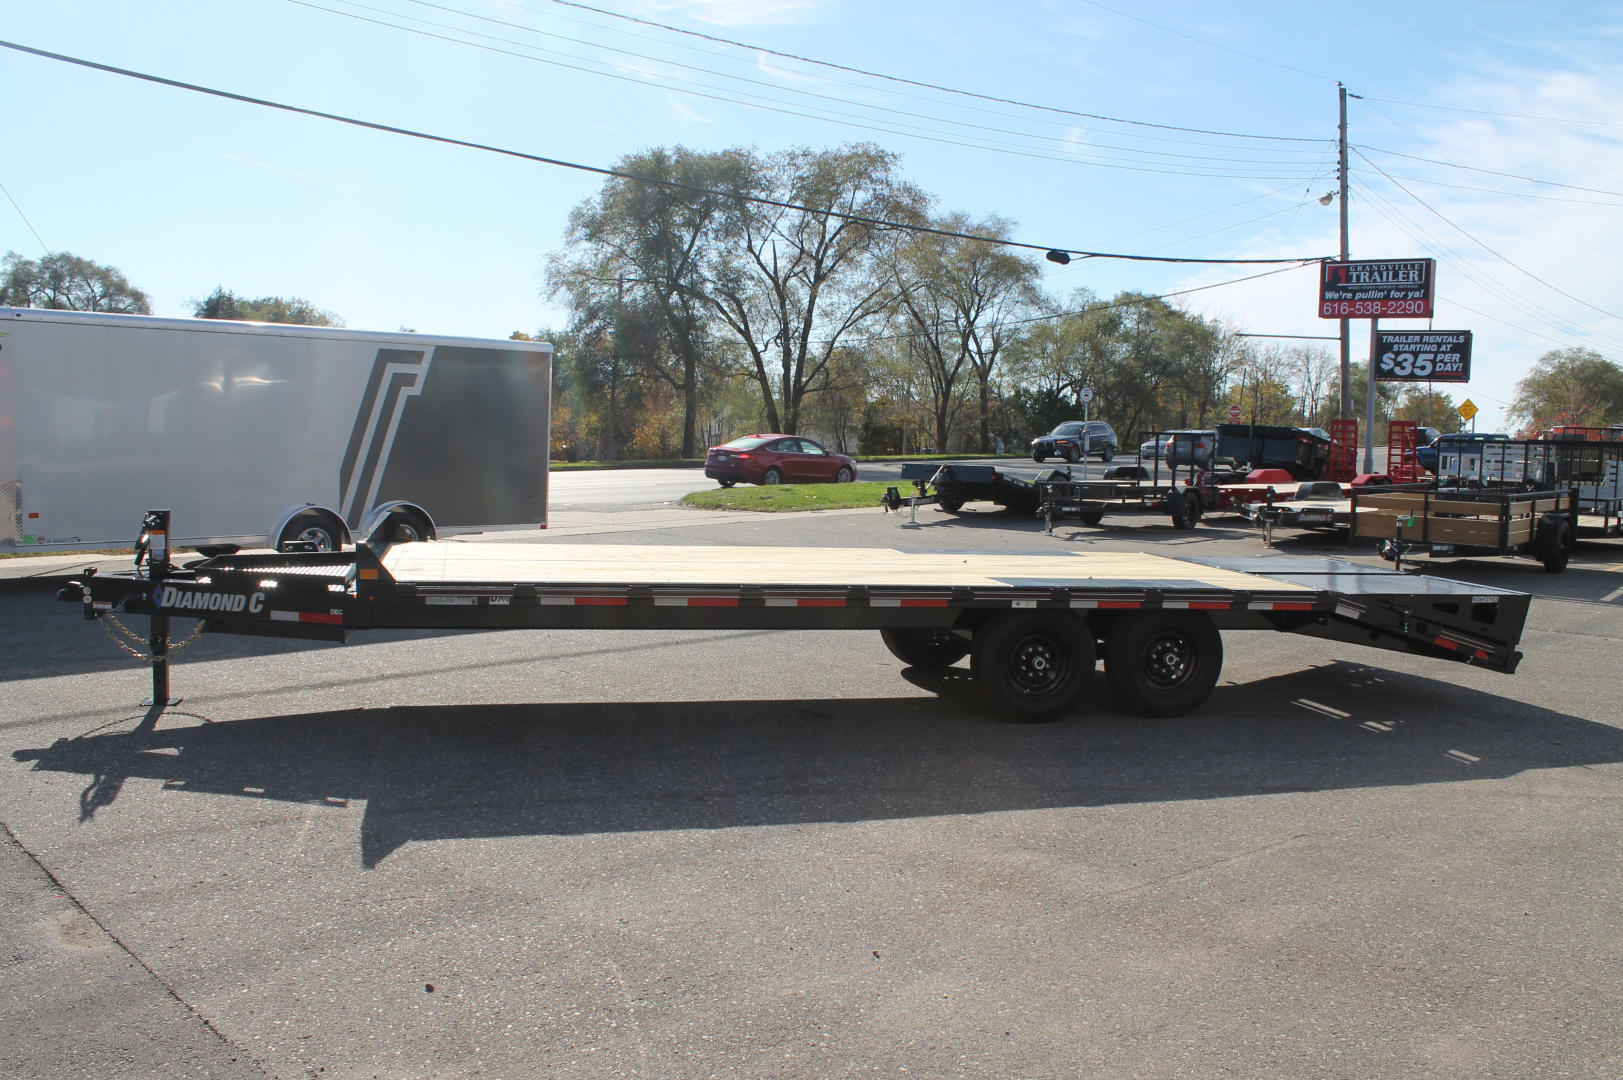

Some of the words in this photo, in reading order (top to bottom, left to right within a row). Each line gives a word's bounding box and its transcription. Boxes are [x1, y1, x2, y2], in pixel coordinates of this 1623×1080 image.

[1349, 263, 1420, 272] GRANDVILLE
[1348, 270, 1420, 283] TRAILER
[1325, 290, 1353, 300] We're
[1355, 290, 1387, 300] pullin'
[1389, 289, 1405, 299] for
[1406, 289, 1424, 300] ya!
[1323, 300, 1424, 315] 616-538-2290
[1382, 335, 1421, 343] TRAILER
[1422, 335, 1465, 343] RENTALS
[1392, 344, 1438, 352] STARTING
[1439, 344, 1453, 352] AT
[1436, 353, 1461, 362] PER
[1380, 351, 1435, 377] $35
[1435, 363, 1464, 372] DAY!
[160, 586, 246, 613] DIAMOND
[249, 592, 266, 614] C
[330, 608, 343, 616] DEC
